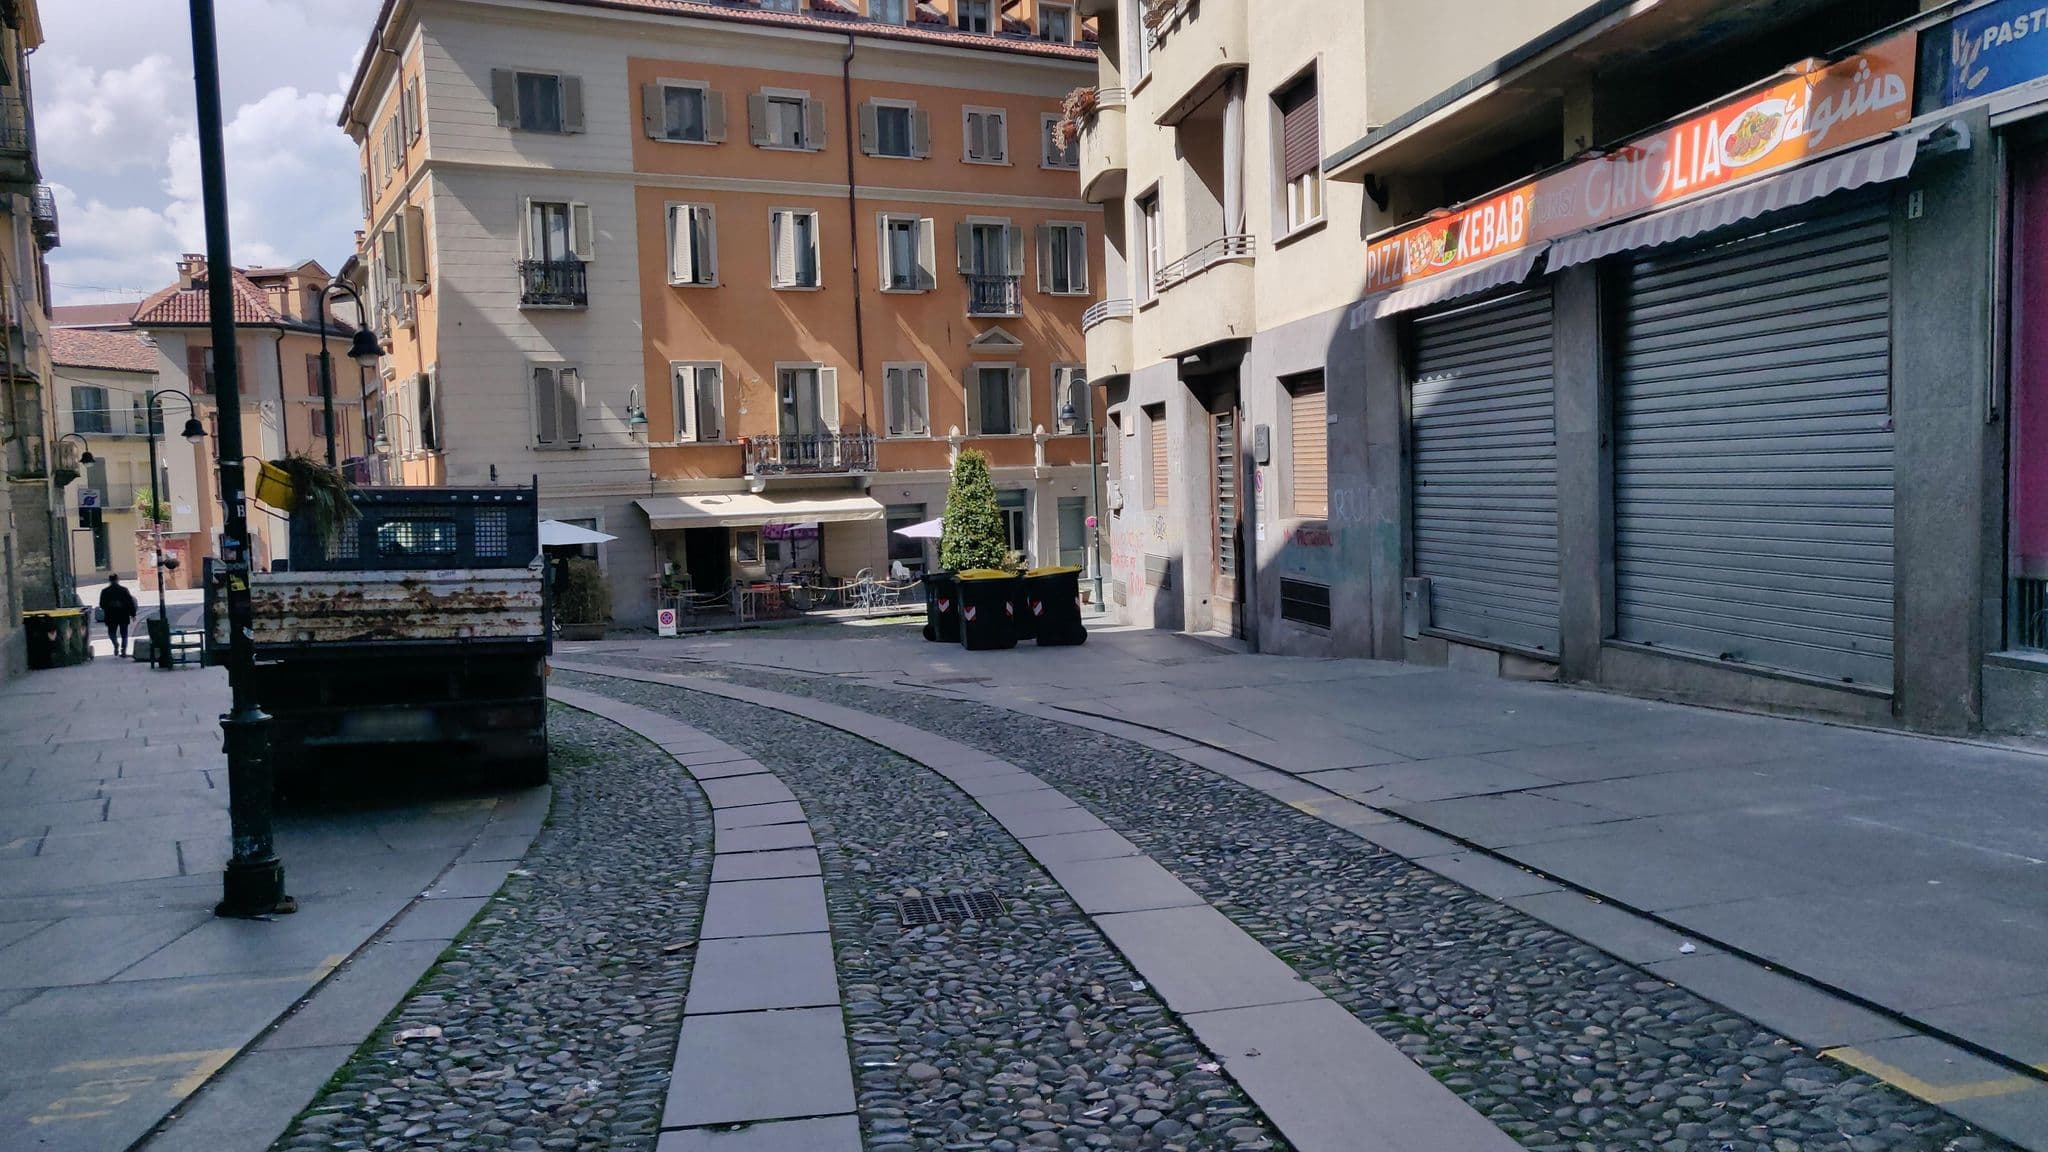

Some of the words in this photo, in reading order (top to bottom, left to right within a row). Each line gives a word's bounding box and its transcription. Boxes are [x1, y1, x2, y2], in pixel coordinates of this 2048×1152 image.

[1367, 237, 1412, 289] PIZZA
[1457, 195, 1524, 261] KEBAB
[1585, 118, 1721, 218] GRIGLIA
